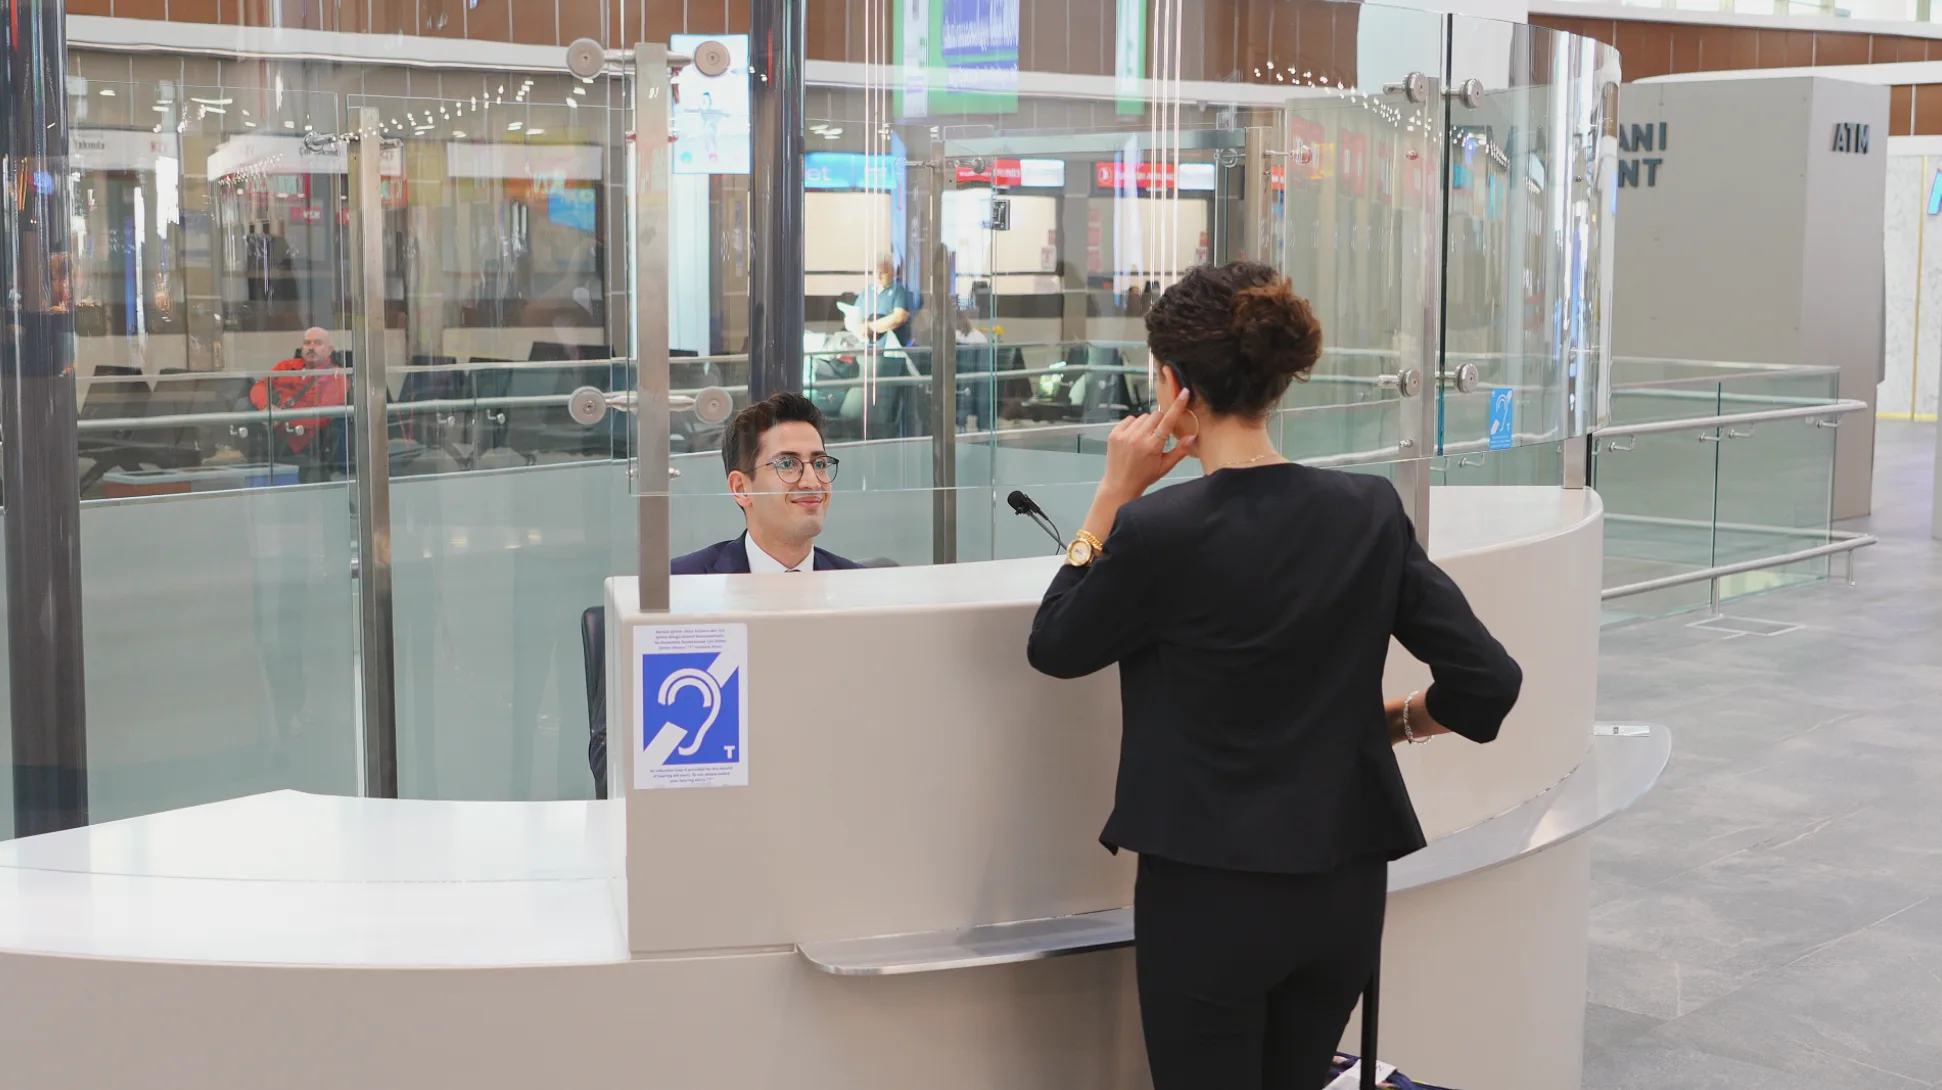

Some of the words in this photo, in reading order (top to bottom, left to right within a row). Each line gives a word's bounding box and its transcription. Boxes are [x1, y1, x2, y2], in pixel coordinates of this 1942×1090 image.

[1831, 122, 1870, 154] ATM
[1618, 158, 1663, 188] NT
[723, 745, 736, 760] T
